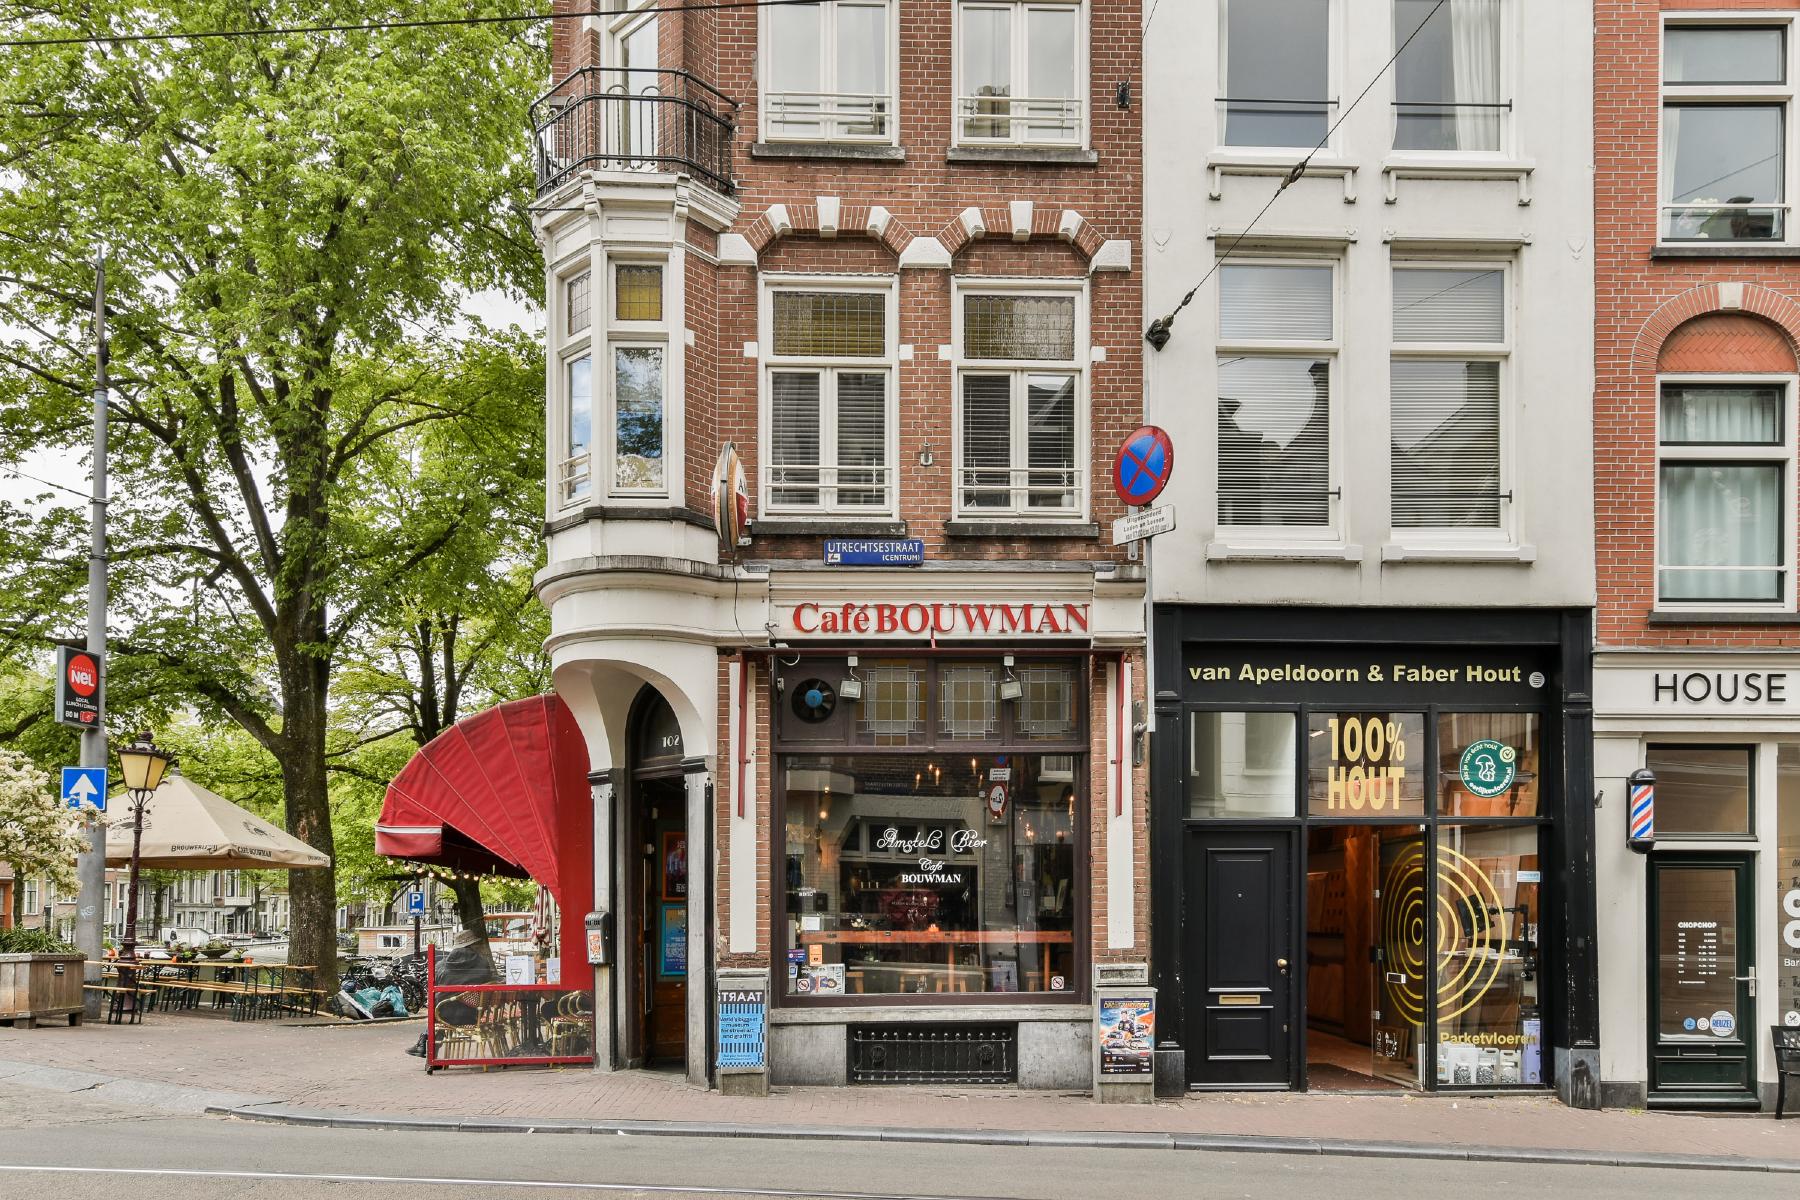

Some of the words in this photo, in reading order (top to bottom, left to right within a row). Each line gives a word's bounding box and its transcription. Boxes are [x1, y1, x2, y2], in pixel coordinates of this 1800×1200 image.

[828, 542, 920, 553] UTRECHTSESTRAAT
[792, 602, 870, 633] Café
[874, 603, 1091, 633] BOUWMAN
[1189, 665, 1231, 681] van
[1238, 663, 1359, 685] Apeldoorn
[1367, 665, 1384, 682] &
[1393, 665, 1458, 682] Faber
[1466, 665, 1521, 682] Hout
[1654, 672, 1787, 702] HOUSE
[662, 734, 680, 748] 102
[1328, 717, 1405, 762] 100%
[1327, 765, 1405, 810] HOUT
[950, 829, 988, 853] Bier
[918, 857, 946, 874] Café
[901, 874, 961, 883] BOUWMAN
[411, 893, 421, 907] P
[1677, 921, 1717, 929] CHOPCHOP
[1712, 1018, 1733, 1028] REUZEL
[1440, 1031, 1536, 1045] Parketvloeren
